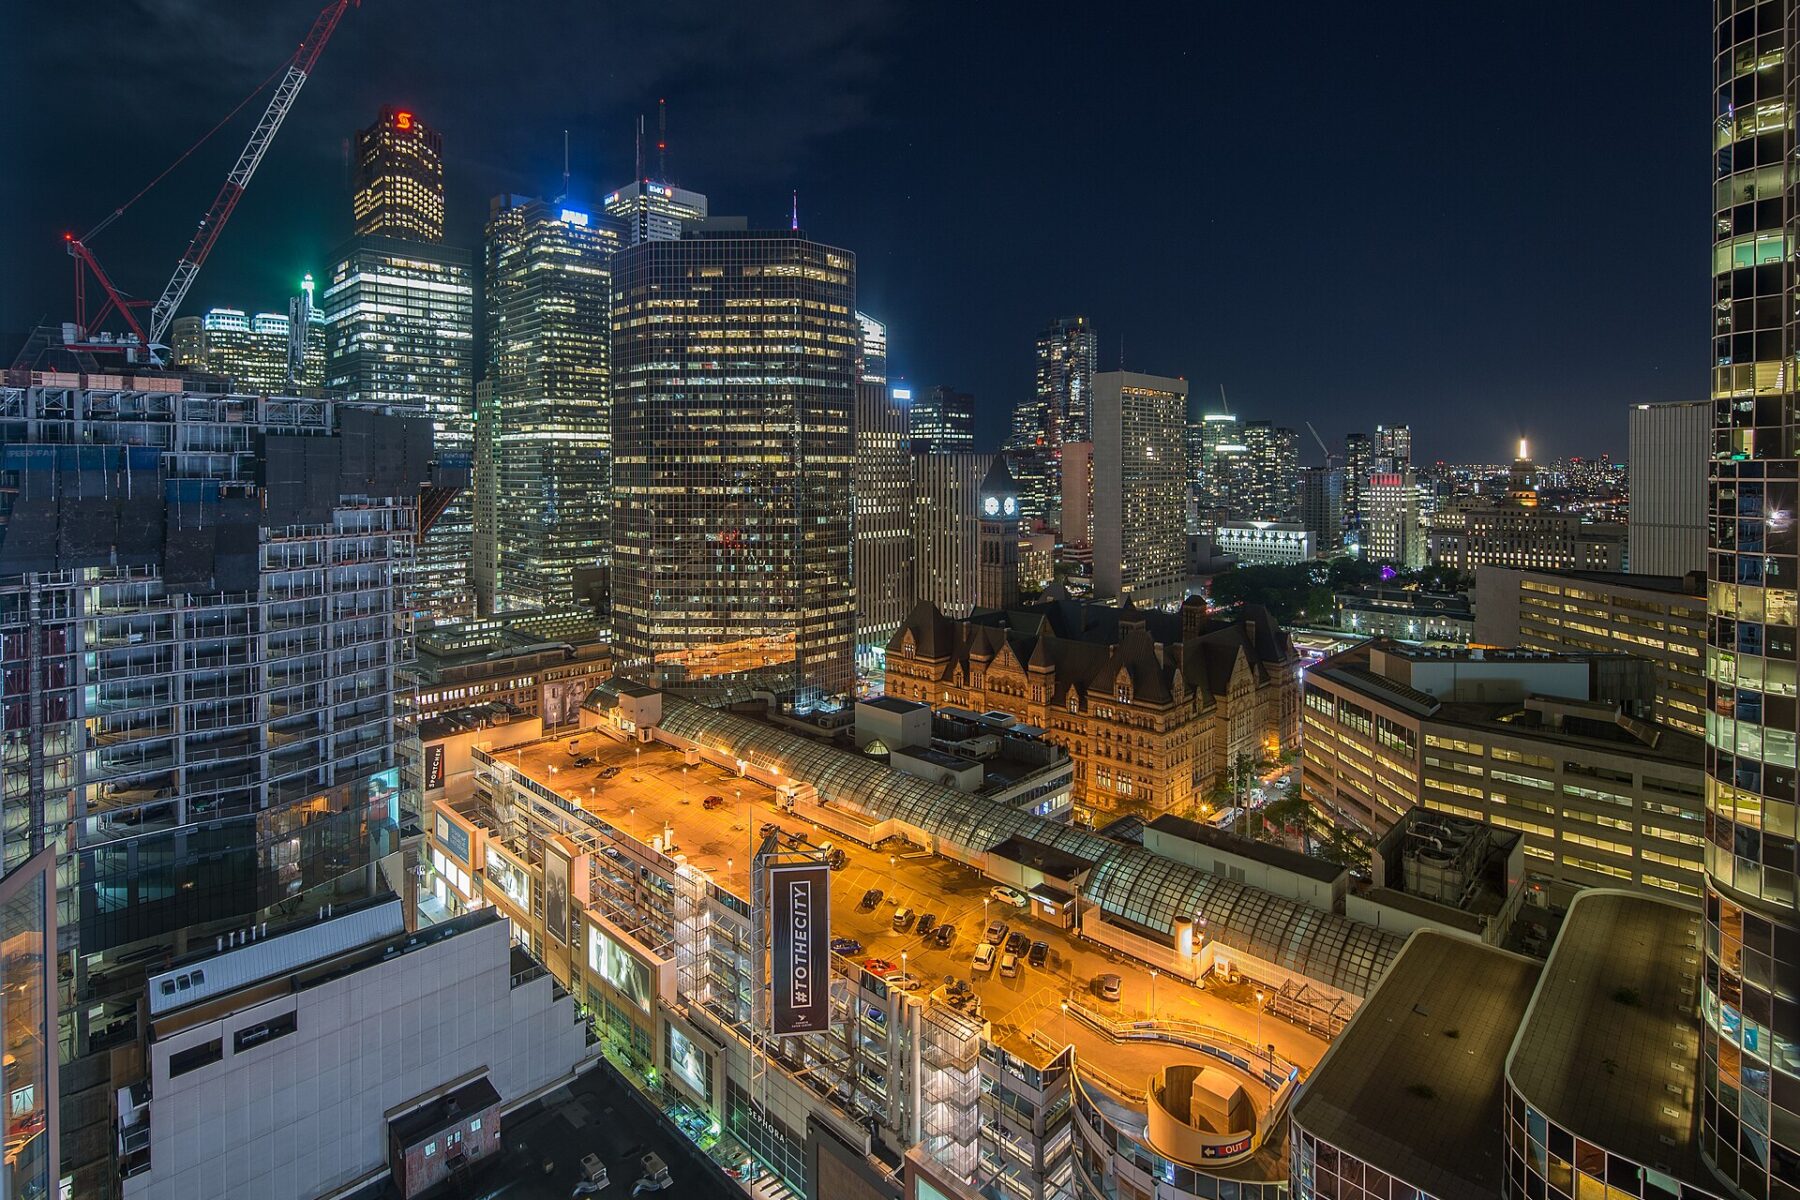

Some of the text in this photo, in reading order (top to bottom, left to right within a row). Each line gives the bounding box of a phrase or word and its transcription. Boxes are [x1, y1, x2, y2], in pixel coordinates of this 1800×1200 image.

[428, 747, 442, 788] SPORTCHEK
[794, 886, 808, 1004] #TOTHECITY
[748, 1107, 785, 1143] SEPHORA
[1225, 1142, 1243, 1154] OUT
